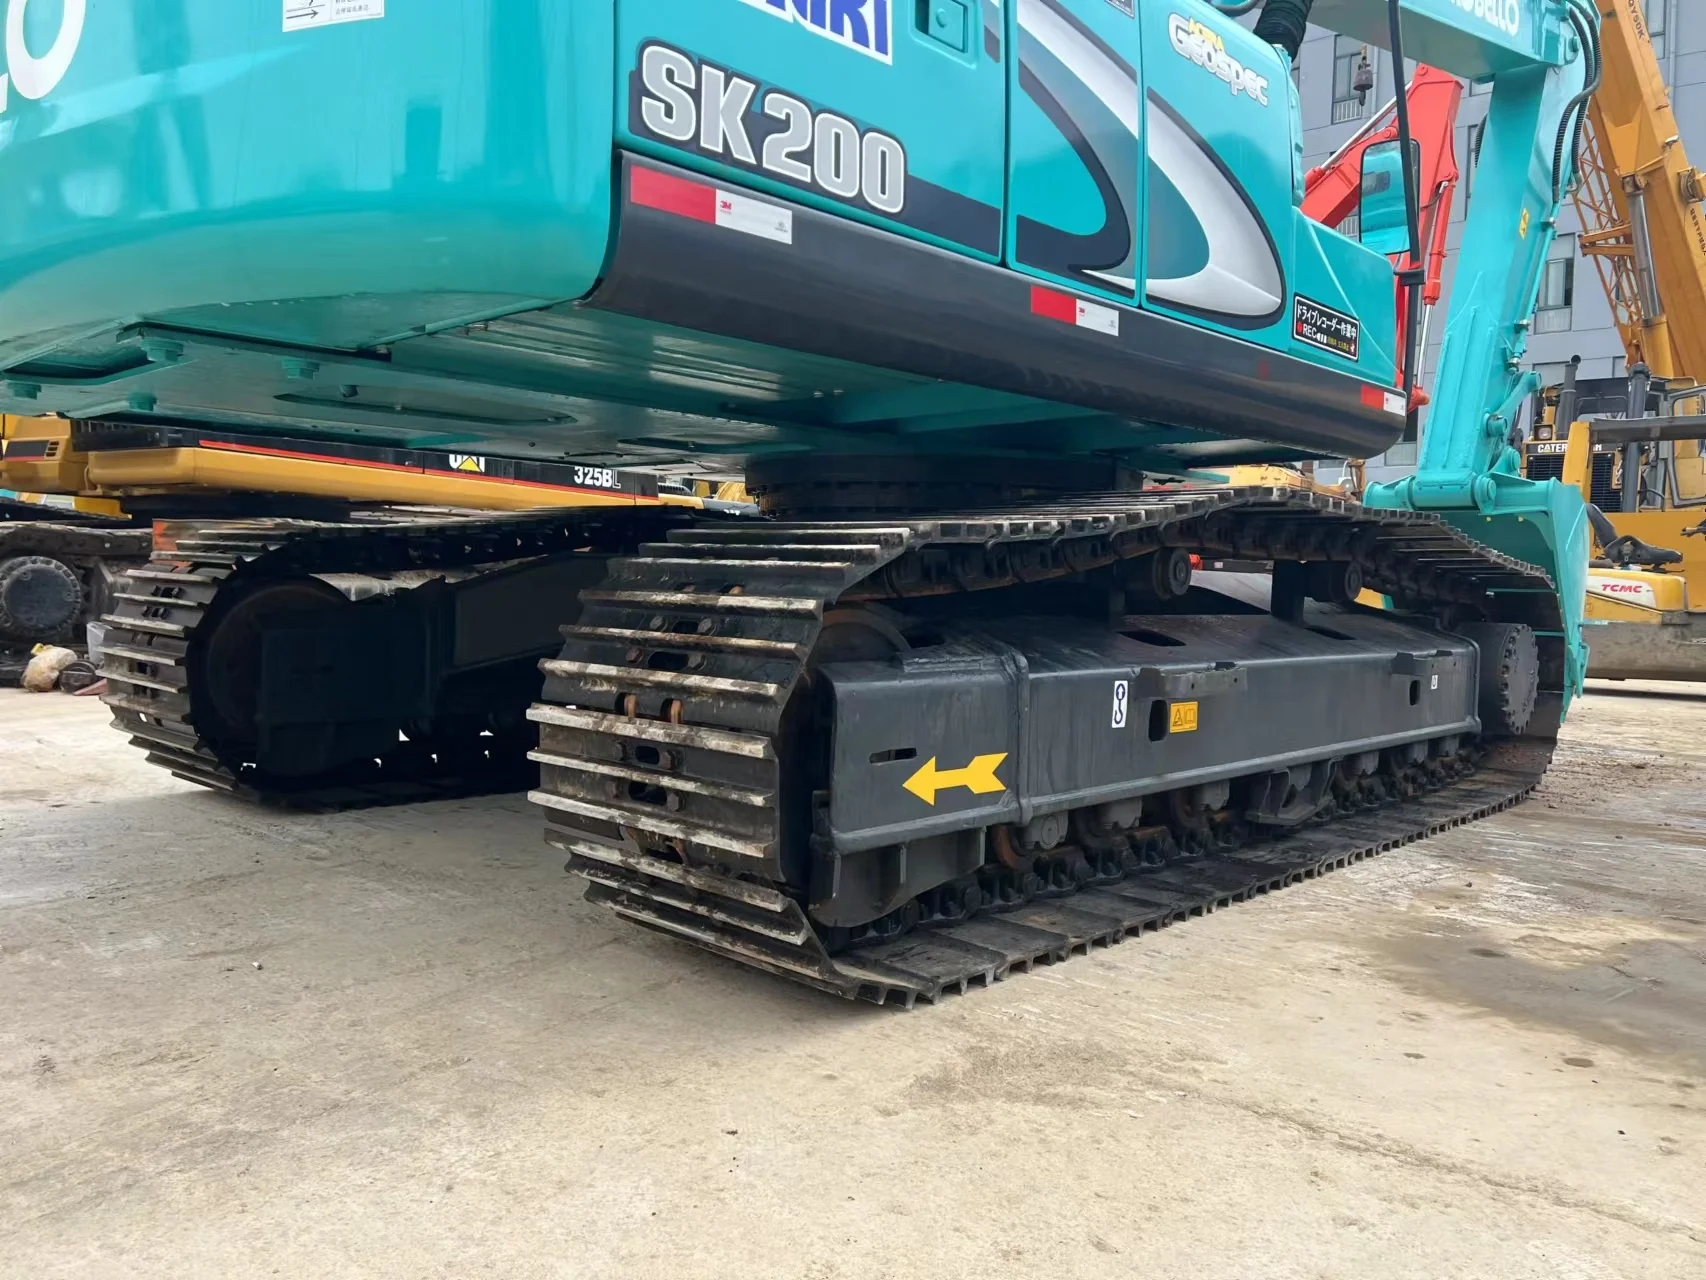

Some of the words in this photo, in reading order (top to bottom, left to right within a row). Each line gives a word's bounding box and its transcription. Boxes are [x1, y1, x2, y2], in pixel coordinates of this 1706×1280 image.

[641, 45, 905, 213] SK200
[1303, 323, 1317, 338] REC
[573, 465, 622, 489] 325BL
